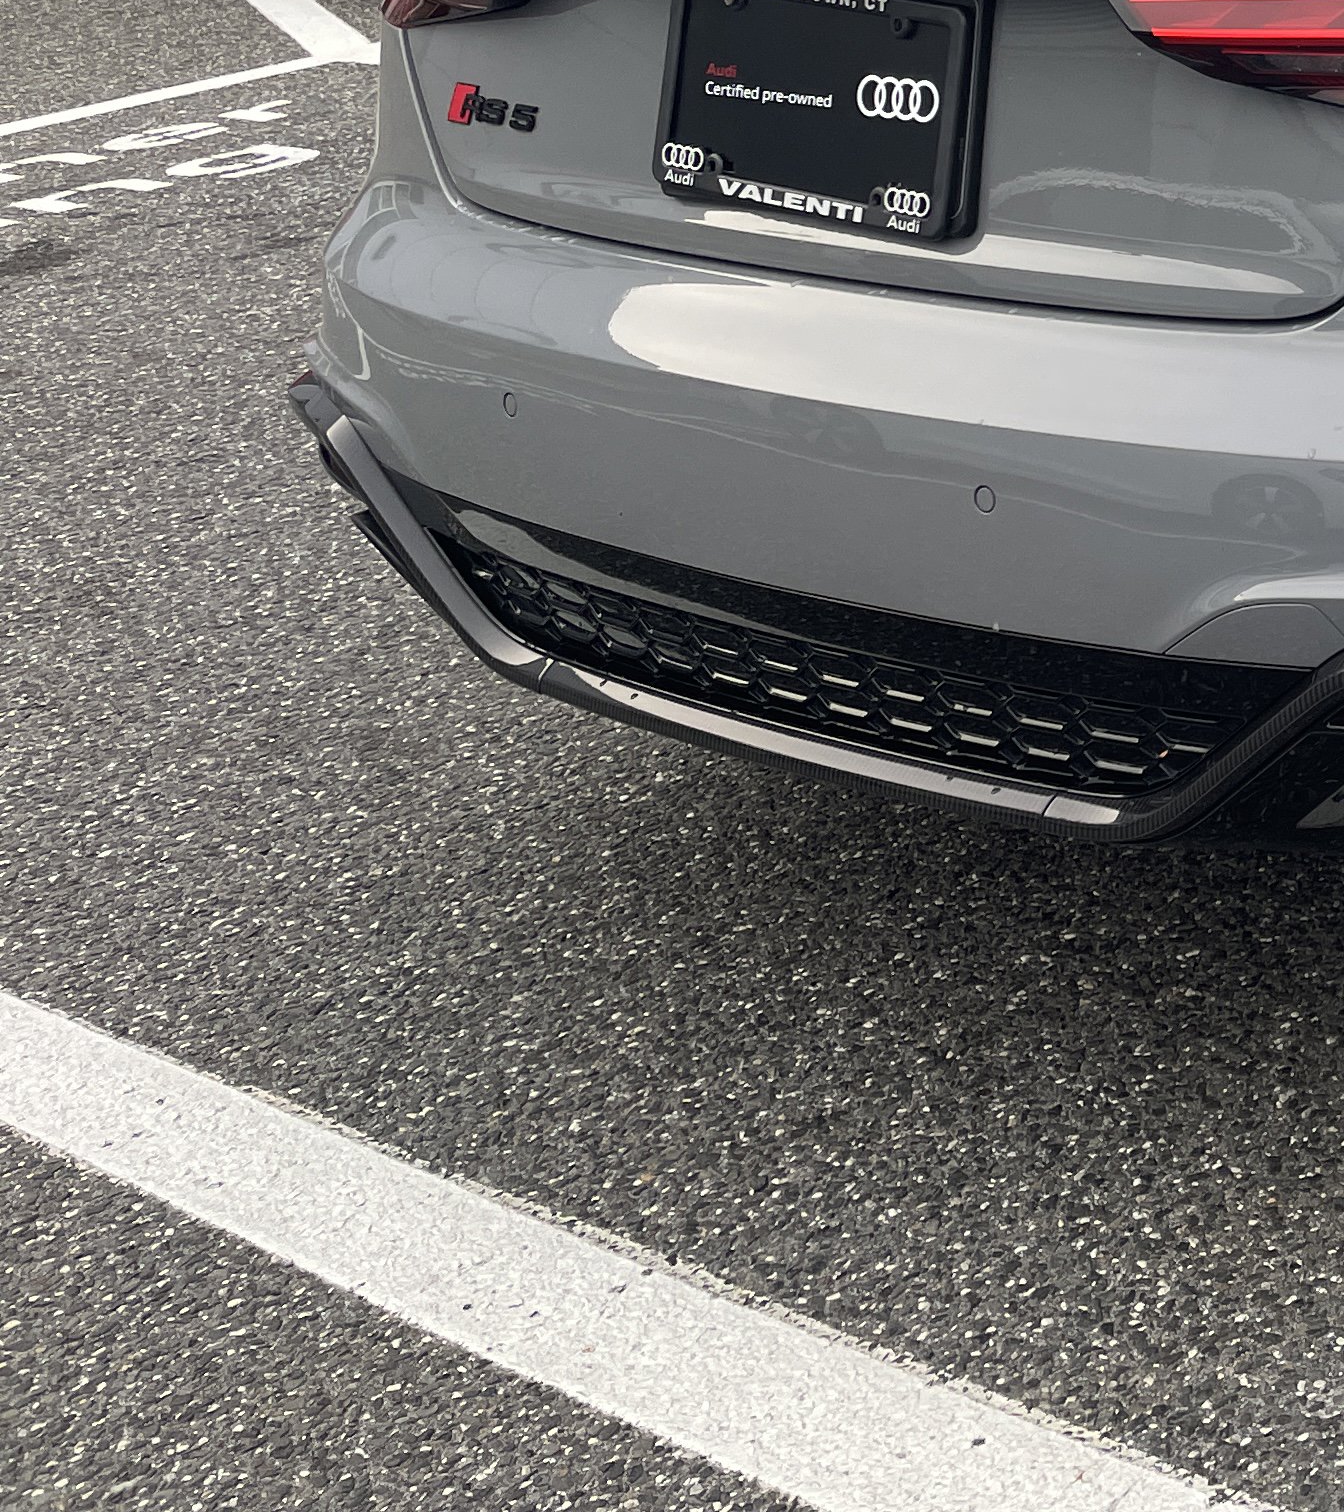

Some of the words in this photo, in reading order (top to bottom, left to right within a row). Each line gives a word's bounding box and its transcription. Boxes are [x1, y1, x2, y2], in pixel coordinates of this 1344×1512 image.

[705, 62, 737, 78] Audi
[705, 81, 759, 101] Certified
[761, 88, 833, 108] pre-owned
[664, 169, 694, 187] Audi
[718, 178, 864, 224] VALENTI
[886, 215, 921, 234] Audi
